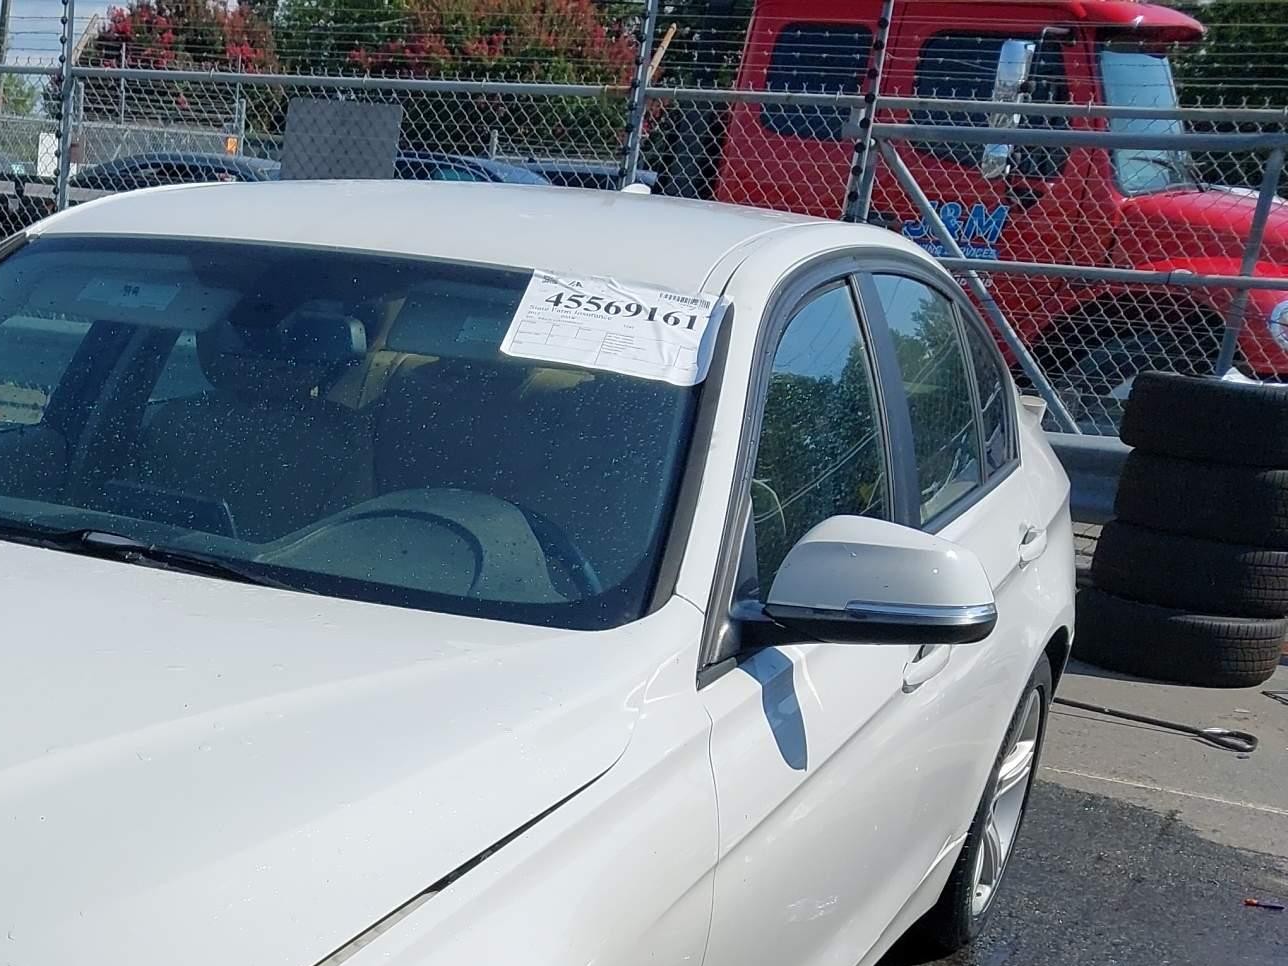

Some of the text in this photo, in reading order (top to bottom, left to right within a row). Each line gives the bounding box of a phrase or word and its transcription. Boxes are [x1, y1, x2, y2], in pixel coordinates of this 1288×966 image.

[544, 291, 699, 331] 45569161
[551, 305, 572, 315] Farm
[573, 310, 614, 321] Insurance
